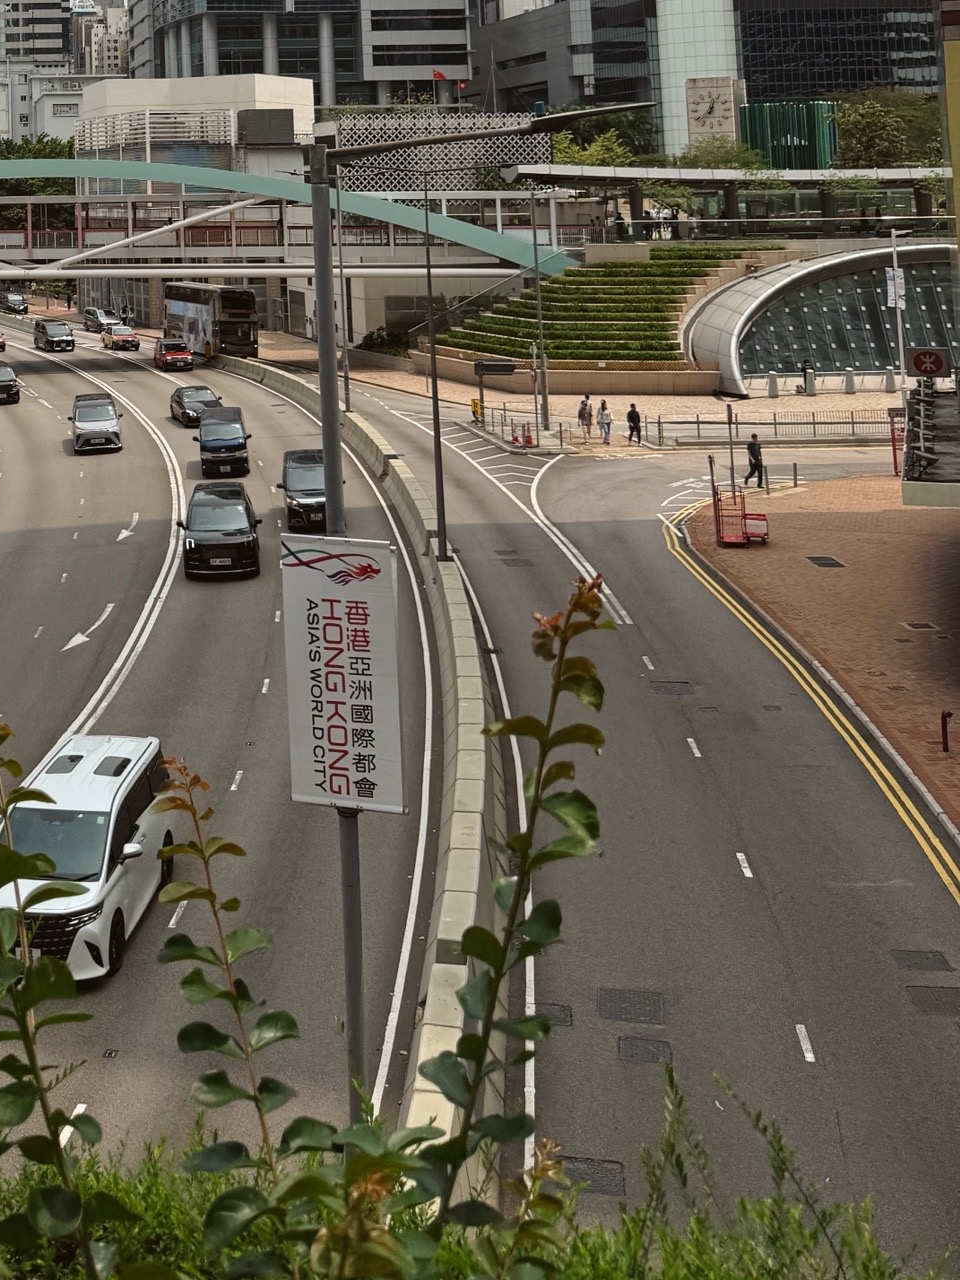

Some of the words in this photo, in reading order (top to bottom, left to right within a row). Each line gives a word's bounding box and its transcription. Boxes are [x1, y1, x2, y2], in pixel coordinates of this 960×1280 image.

[306, 597, 322, 663] ASIA'S
[321, 598, 346, 693] HONG
[309, 667, 325, 740] WORLD
[313, 744, 327, 793] CITY
[326, 700, 350, 796] KONG
